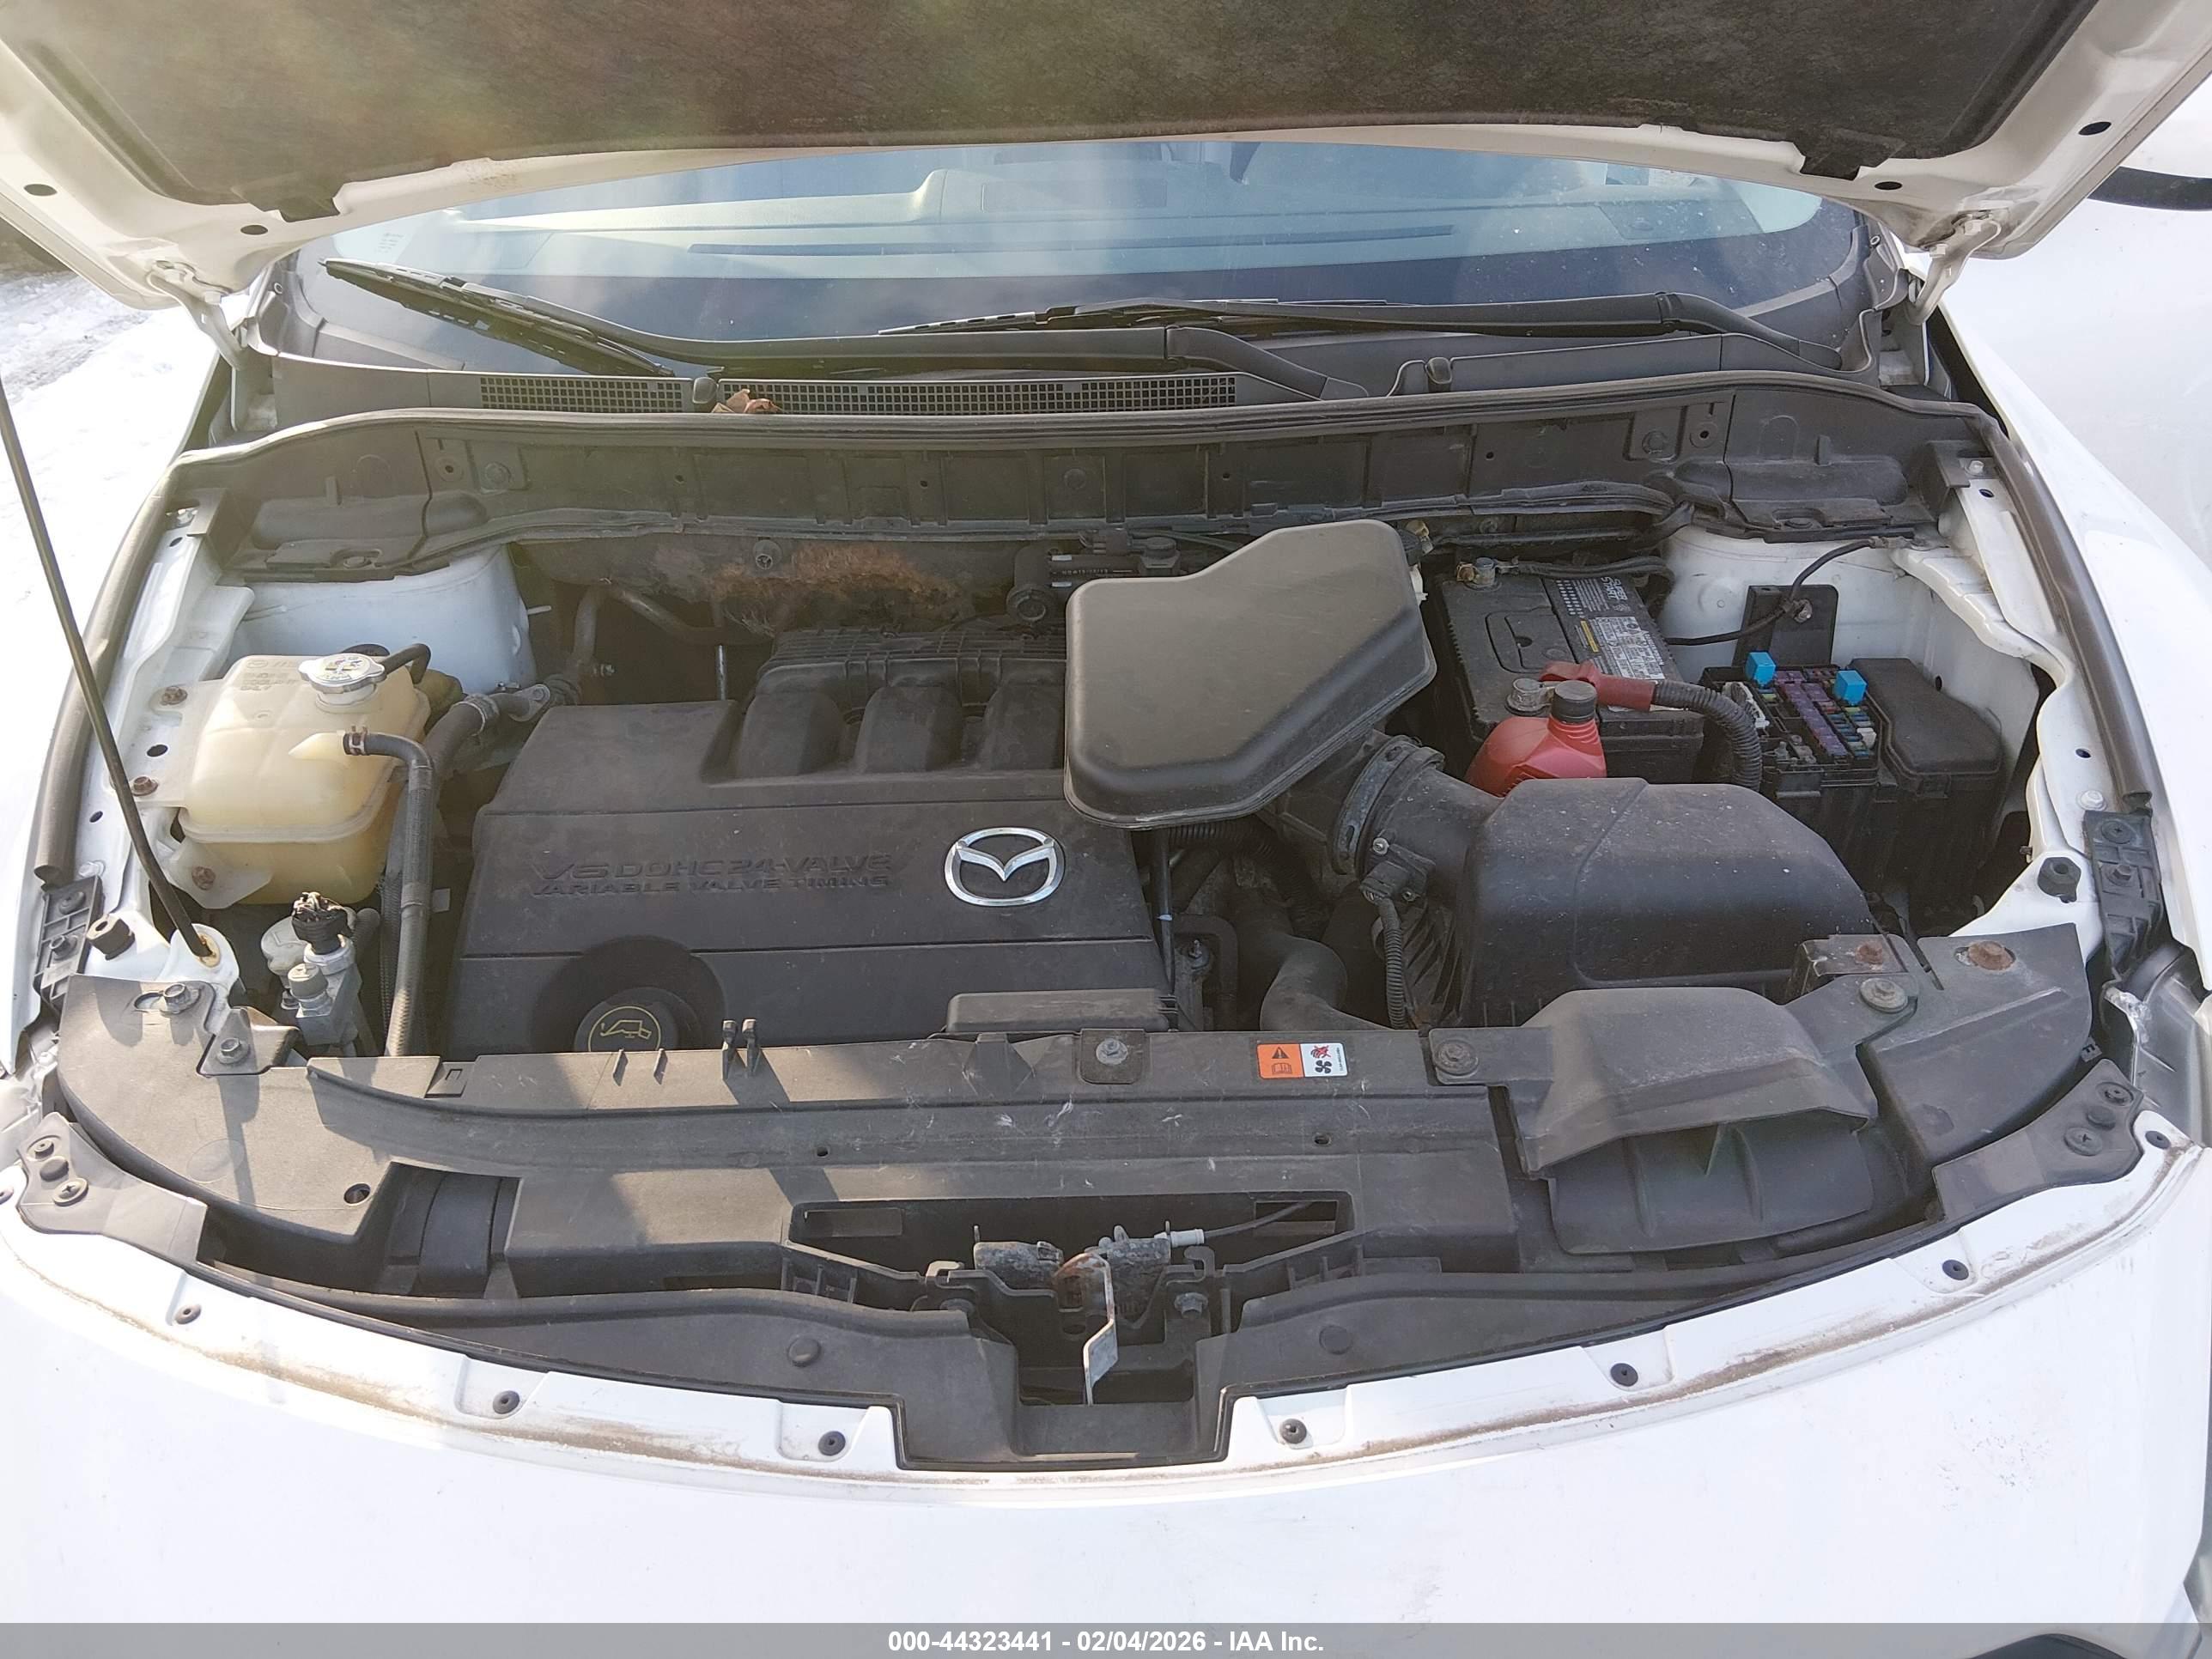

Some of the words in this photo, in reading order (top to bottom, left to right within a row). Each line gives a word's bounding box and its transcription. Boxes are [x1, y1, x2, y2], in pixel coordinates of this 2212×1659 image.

[1601, 576, 1620, 600] START
[1614, 578, 1628, 600] SUPER
[531, 881, 681, 896] VARIABLE
[690, 878, 781, 891] VALVE
[788, 875, 890, 890] TIMING
